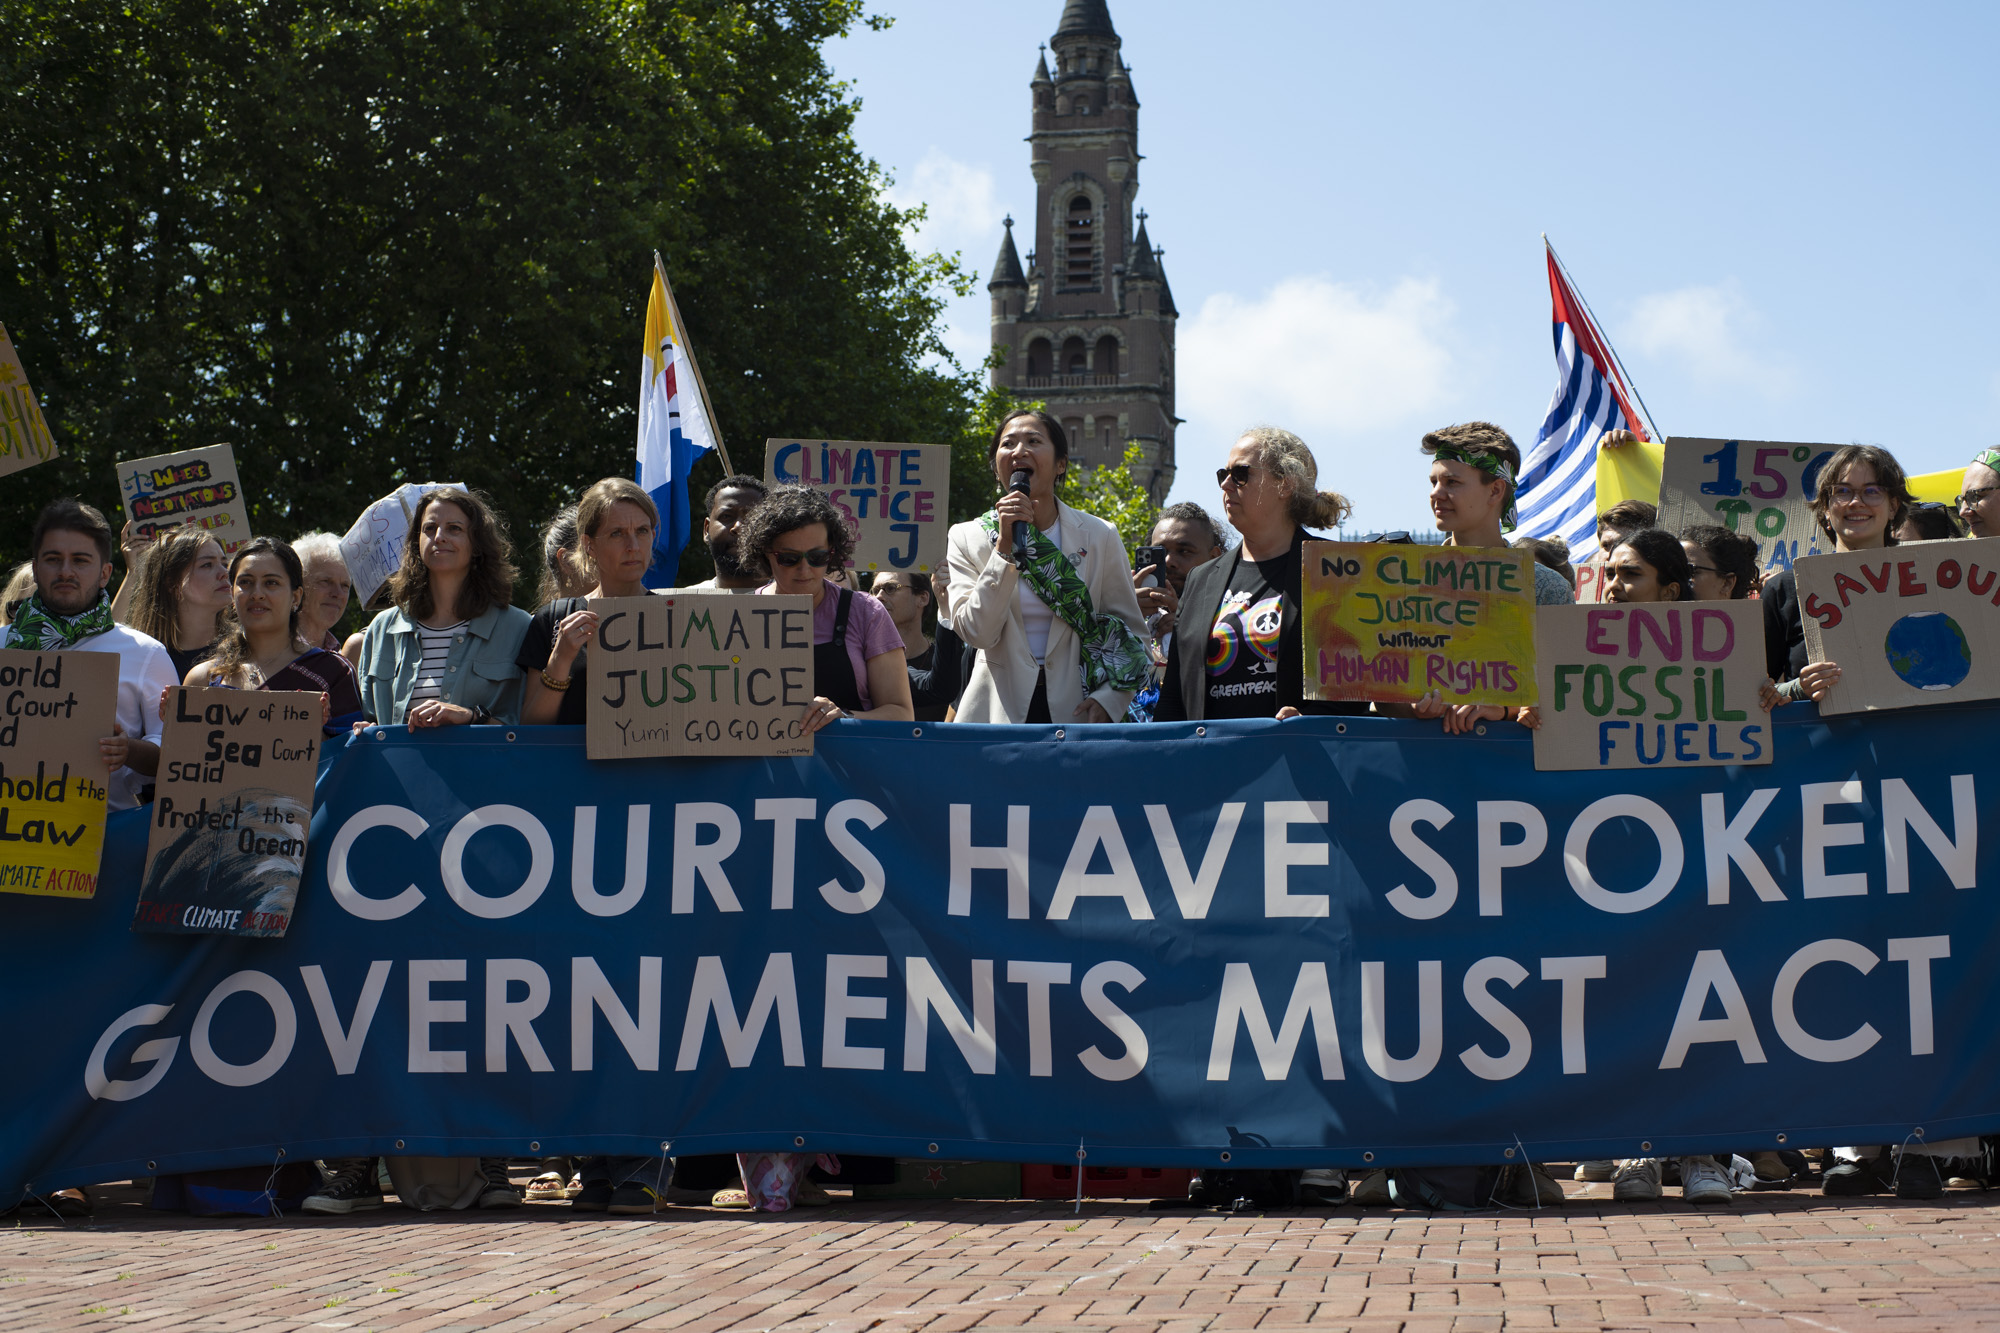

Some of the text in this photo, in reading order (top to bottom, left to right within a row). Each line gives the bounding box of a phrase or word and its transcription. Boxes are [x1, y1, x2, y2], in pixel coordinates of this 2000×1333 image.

[153, 464, 208, 487] WHERE
[773, 442, 922, 486] CLiMATE
[135, 484, 233, 517] NEGOTIATIONS
[828, 485, 935, 523] STiCE
[1714, 498, 1787, 538] TO
[1321, 556, 1523, 592] NO CLIMATE
[1355, 592, 1480, 626] JUSTICE
[1805, 562, 1927, 629] SAVE
[599, 599, 809, 652] CLiMATE
[1586, 608, 1735, 662] END
[0, 656, 61, 688] orld
[602, 654, 809, 709] JUSTiCE
[1210, 680, 1277, 699] GREENPEAC
[1319, 650, 1519, 695] HUMAN RIGHTS
[6, 691, 78, 718] Court
[176, 689, 310, 726] Law of the
[1554, 664, 1747, 722] FOSSiL
[205, 730, 315, 767] Sea Court
[615, 718, 669, 746] Yumi
[1599, 720, 1762, 765] FUELS
[0, 761, 105, 802] hold the
[167, 761, 225, 783] said
[0, 807, 87, 847] Law
[157, 796, 295, 830] Protect the
[238, 827, 305, 857] Ocean
[326, 773, 1978, 921] COURTS HAVE SPOKEN
[0, 863, 98, 895] IMATE ACTION
[139, 901, 289, 931] TAKE CLIMATE ACTION
[84, 934, 1951, 1101] GOVERNMENTS MUST ACT
